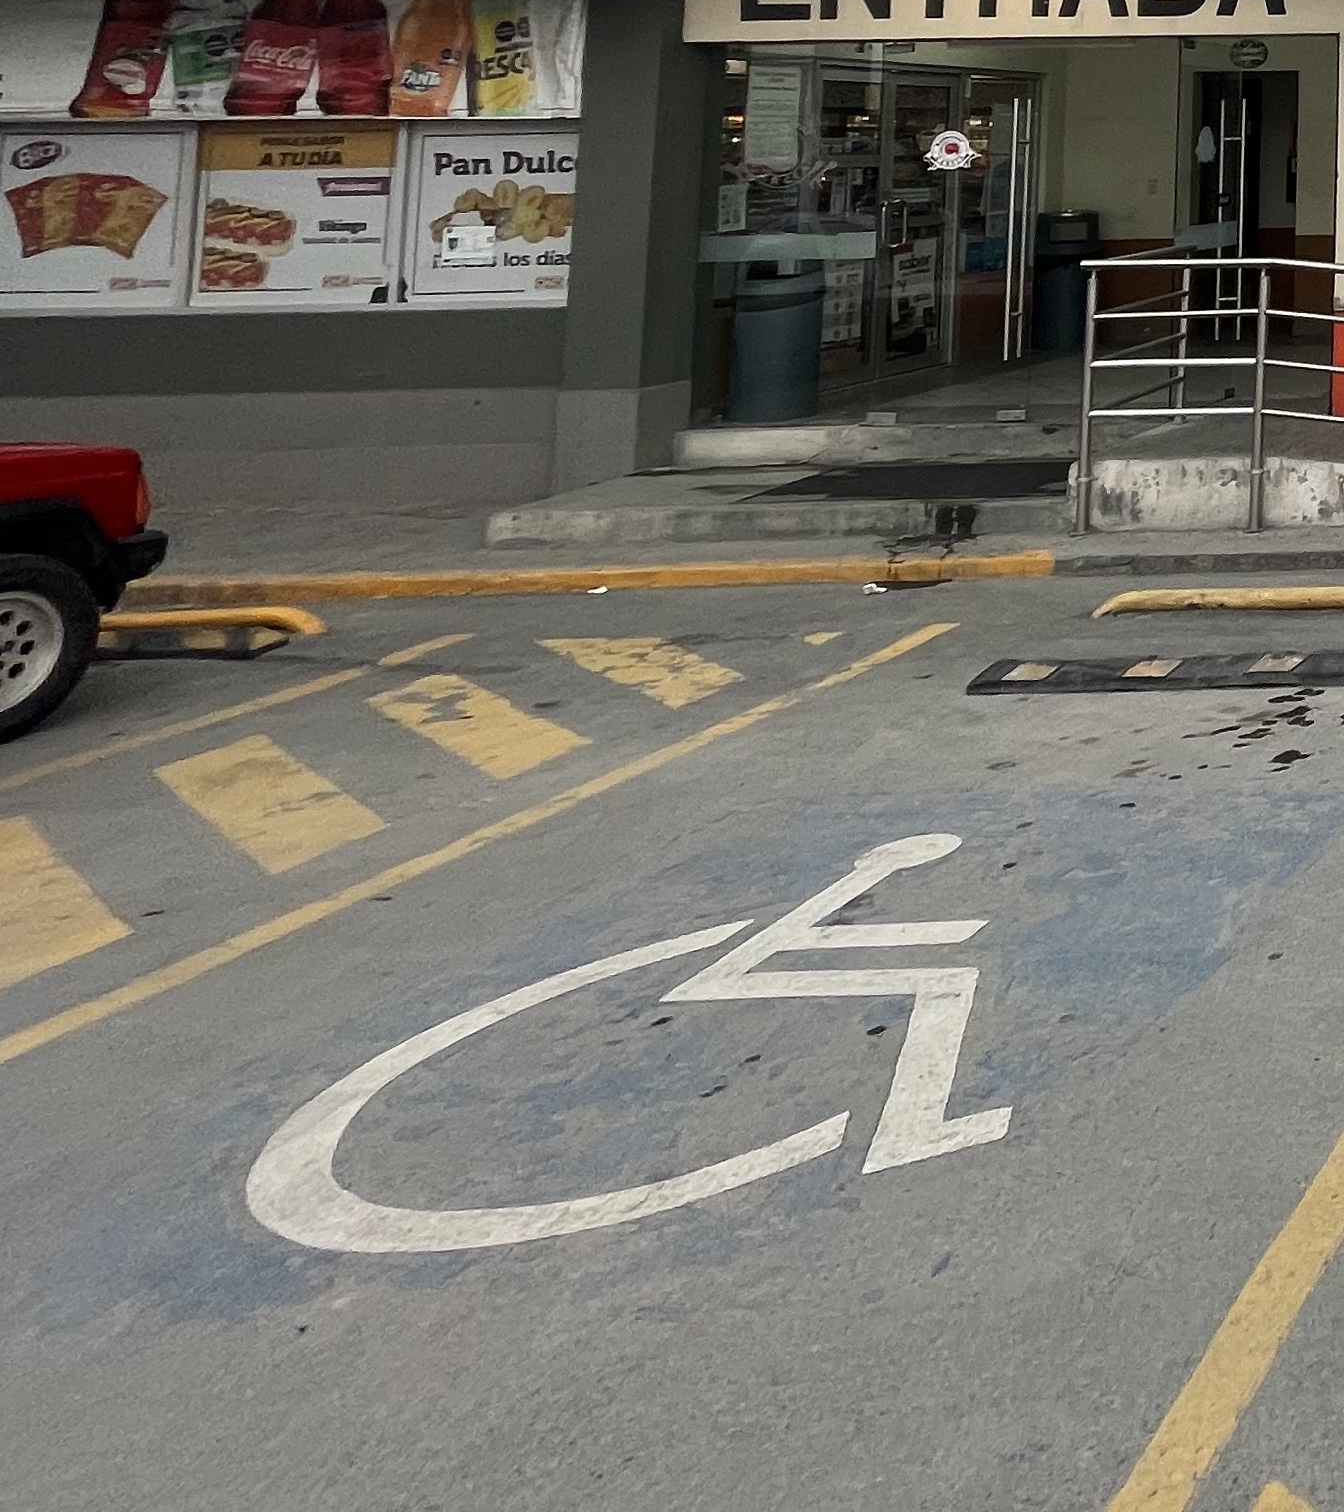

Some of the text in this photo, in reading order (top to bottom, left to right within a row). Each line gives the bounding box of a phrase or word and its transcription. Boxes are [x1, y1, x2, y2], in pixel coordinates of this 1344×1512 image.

[433, 149, 577, 176] Pan Dulc
[503, 252, 531, 267] los
